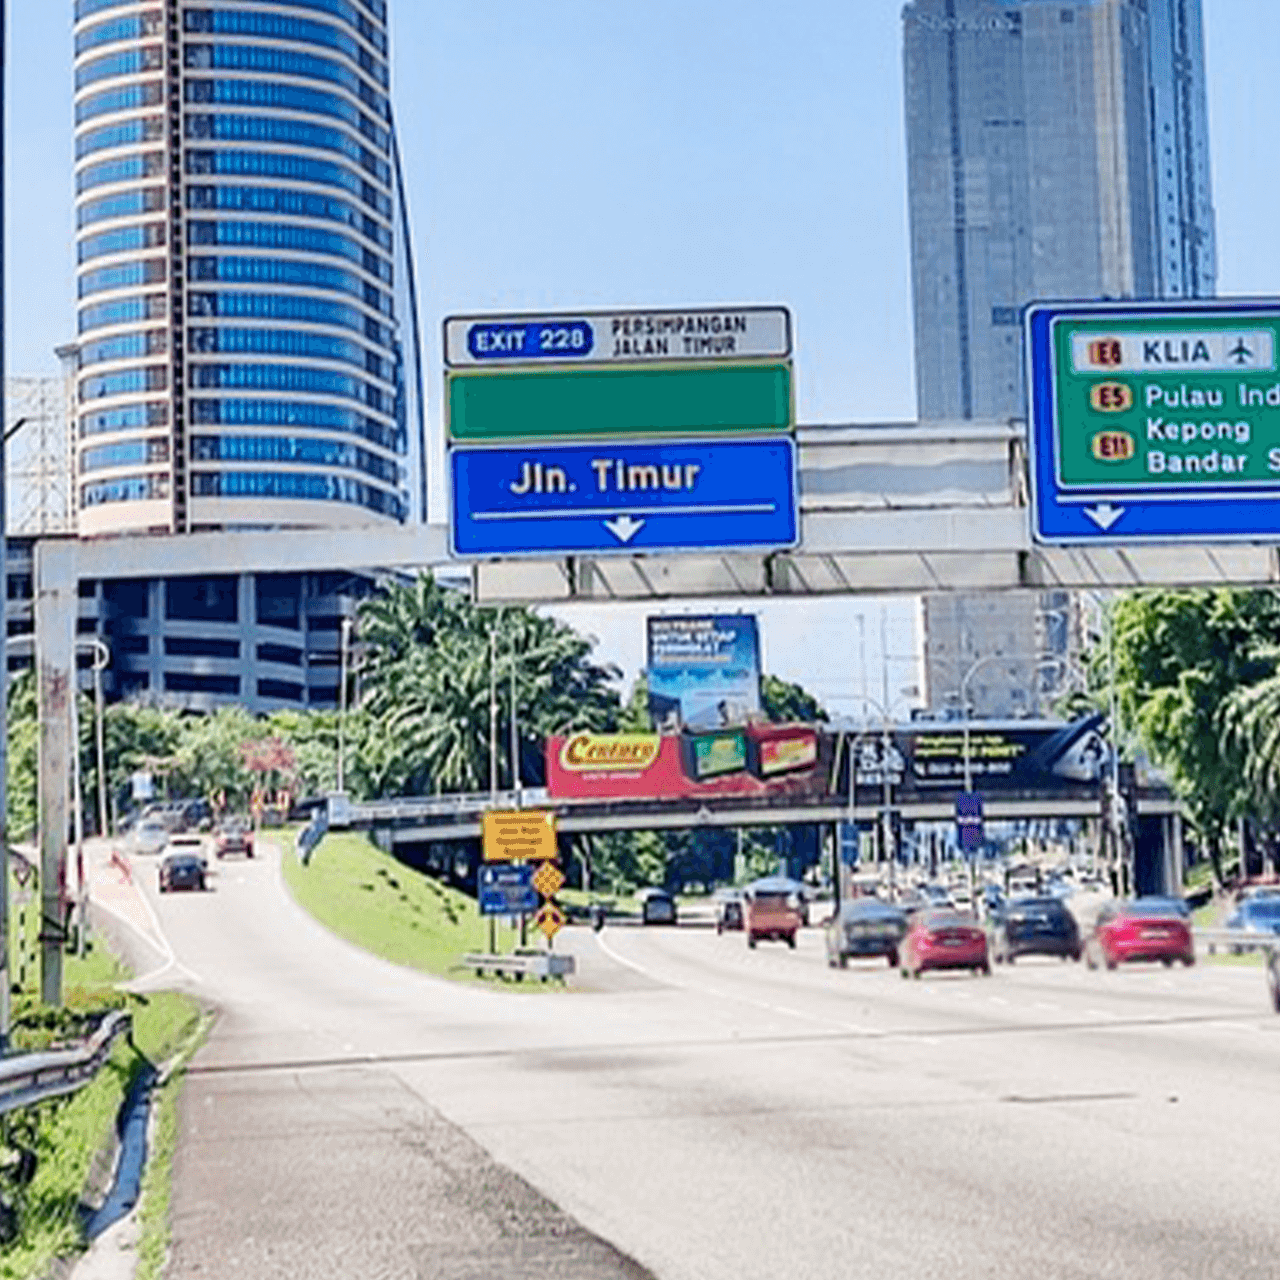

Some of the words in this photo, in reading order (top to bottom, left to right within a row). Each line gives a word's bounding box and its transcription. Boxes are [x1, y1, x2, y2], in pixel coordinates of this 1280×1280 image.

[613, 317, 746, 335] PERSIMPANGAN
[475, 331, 525, 351] EXIT
[613, 337, 669, 356] JALAN
[683, 336, 737, 354] TIMUR
[1143, 341, 1210, 362] KLIA
[1145, 385, 1223, 407] Pulau
[1147, 418, 1250, 443] Kepong
[1147, 450, 1247, 472] Bandar
[510, 462, 577, 494] Jln.
[591, 459, 701, 492] Timur
